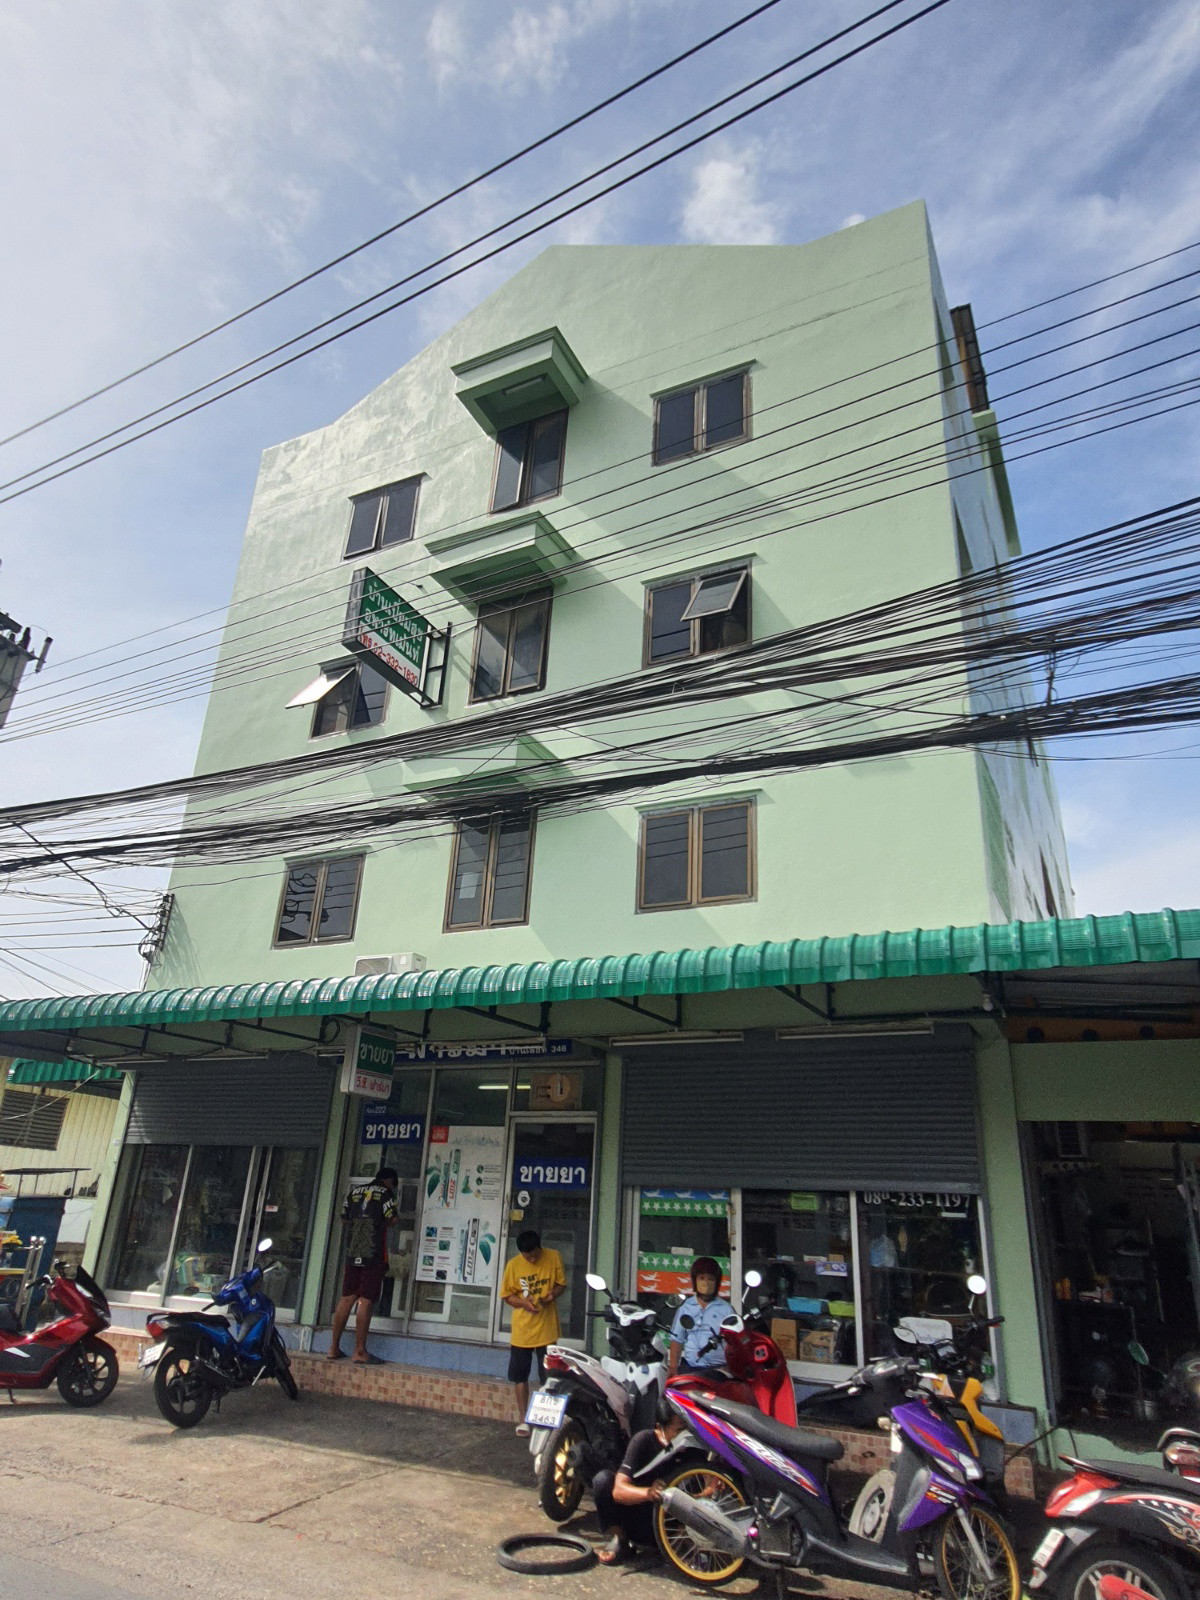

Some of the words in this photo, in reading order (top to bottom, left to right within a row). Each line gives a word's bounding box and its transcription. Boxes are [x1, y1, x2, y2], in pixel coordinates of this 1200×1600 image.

[360, 1043, 394, 1066] ขายยา
[366, 1123, 421, 1139] ขายยา
[520, 1166, 586, 1184] ขายยา
[532, 1413, 556, 1425] 3463
